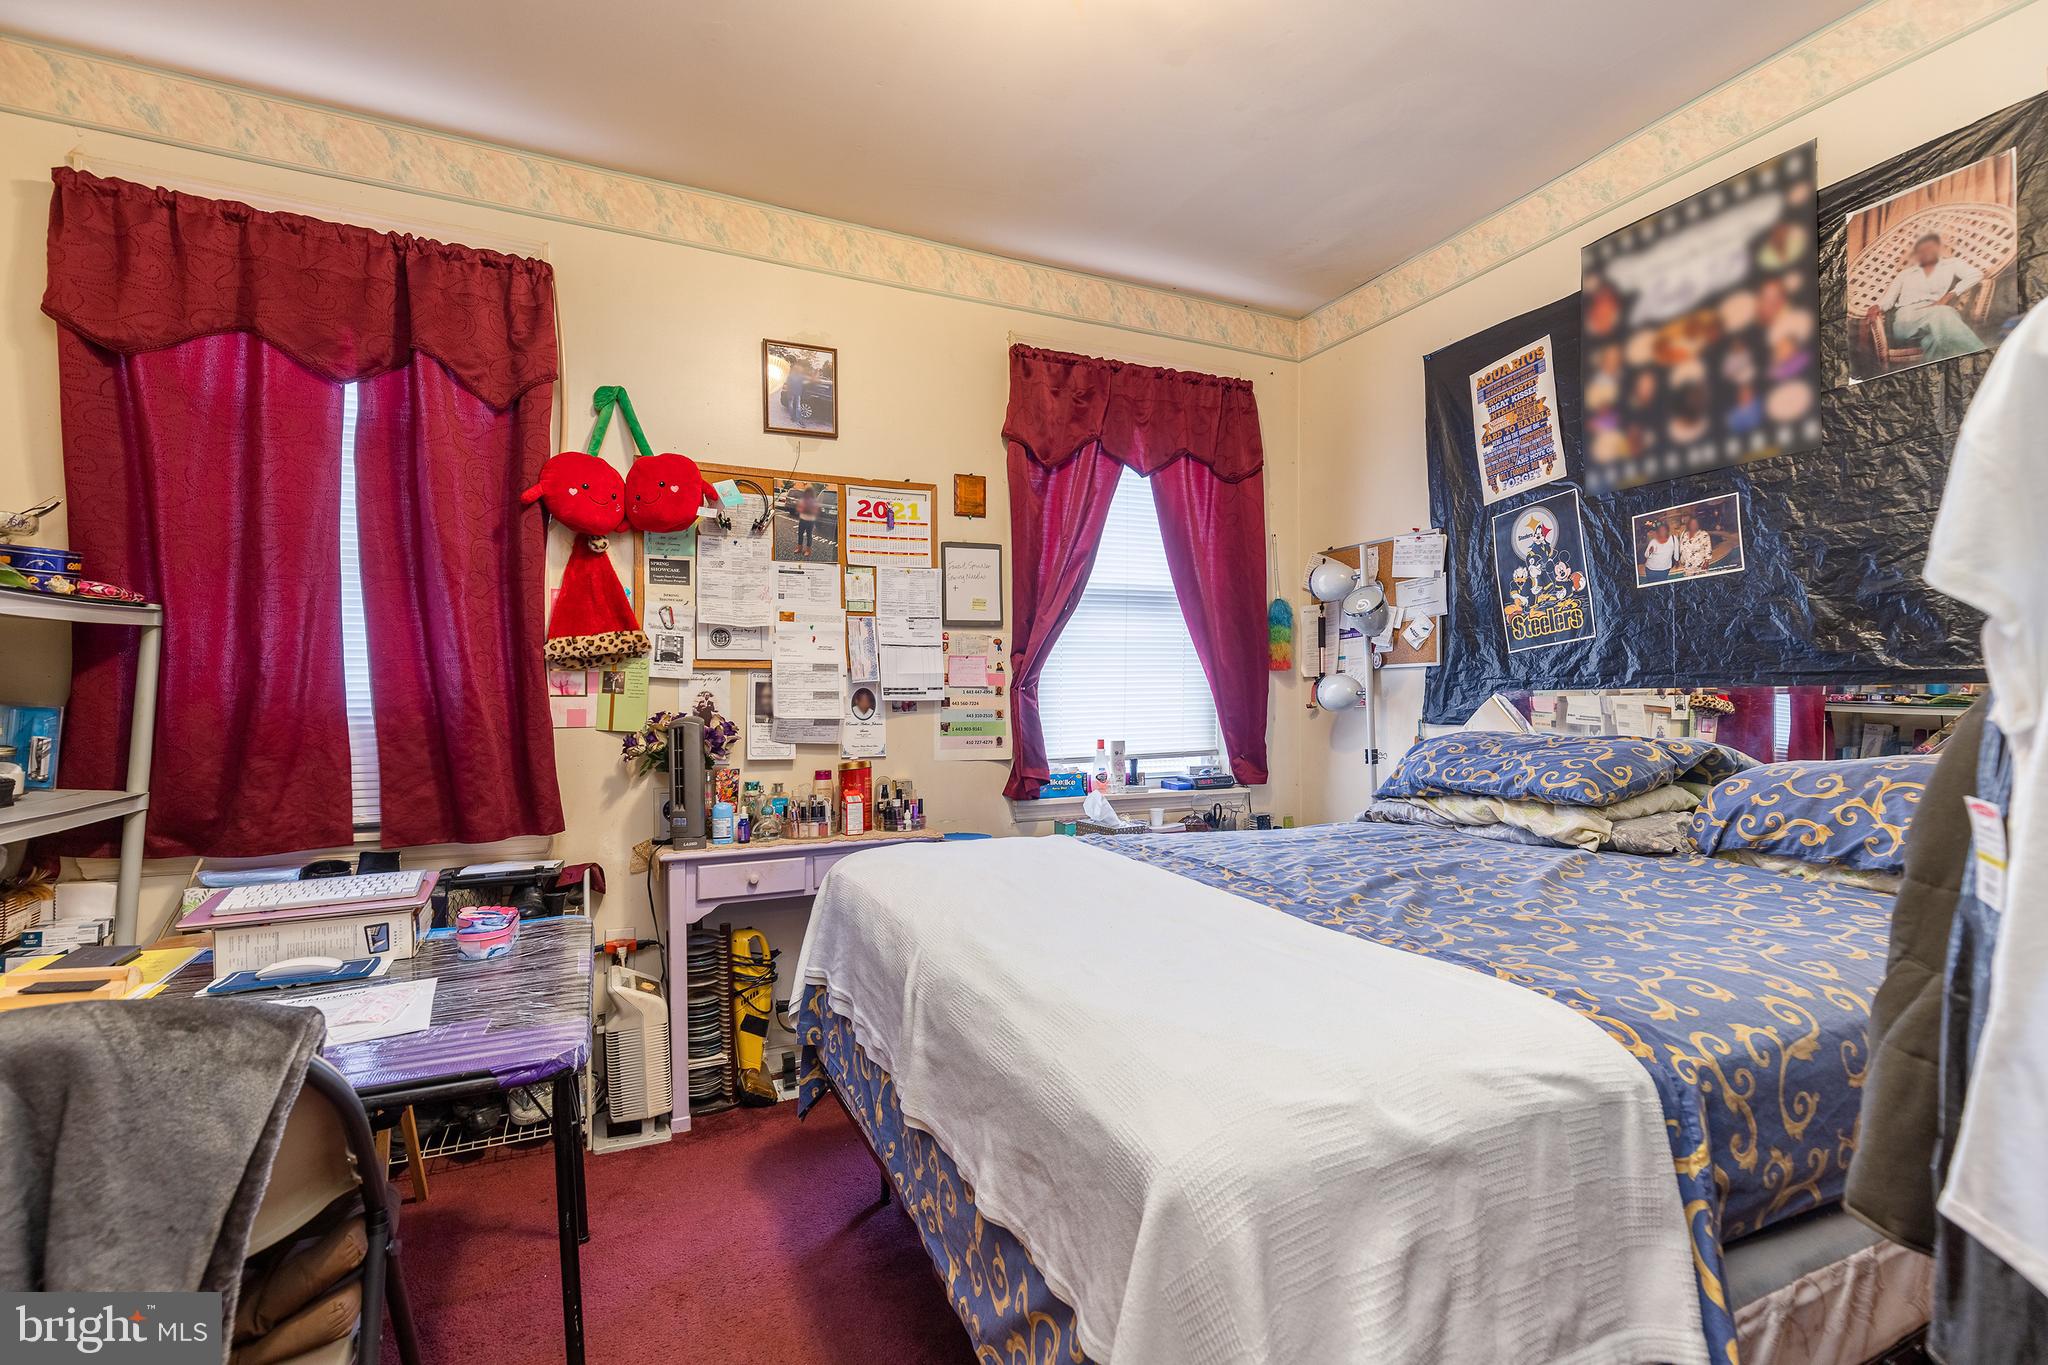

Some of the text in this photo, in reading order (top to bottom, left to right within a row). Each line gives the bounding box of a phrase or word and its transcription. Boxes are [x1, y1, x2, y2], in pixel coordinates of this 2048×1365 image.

[1475, 344, 1544, 390] AQUARIUS
[1484, 376, 1539, 408] TRUSTWORTHY
[1487, 398, 1509, 414] GREAT
[1489, 392, 1537, 421] INTELLIGENT
[1481, 430, 1502, 445] HARD
[1504, 424, 1514, 434] TO
[1517, 408, 1551, 429] HANDLE
[1529, 448, 1545, 460] MOVE
[1502, 467, 1541, 490] FORGET
[857, 499, 920, 520] 2021
[1512, 607, 1583, 640] Steelers
